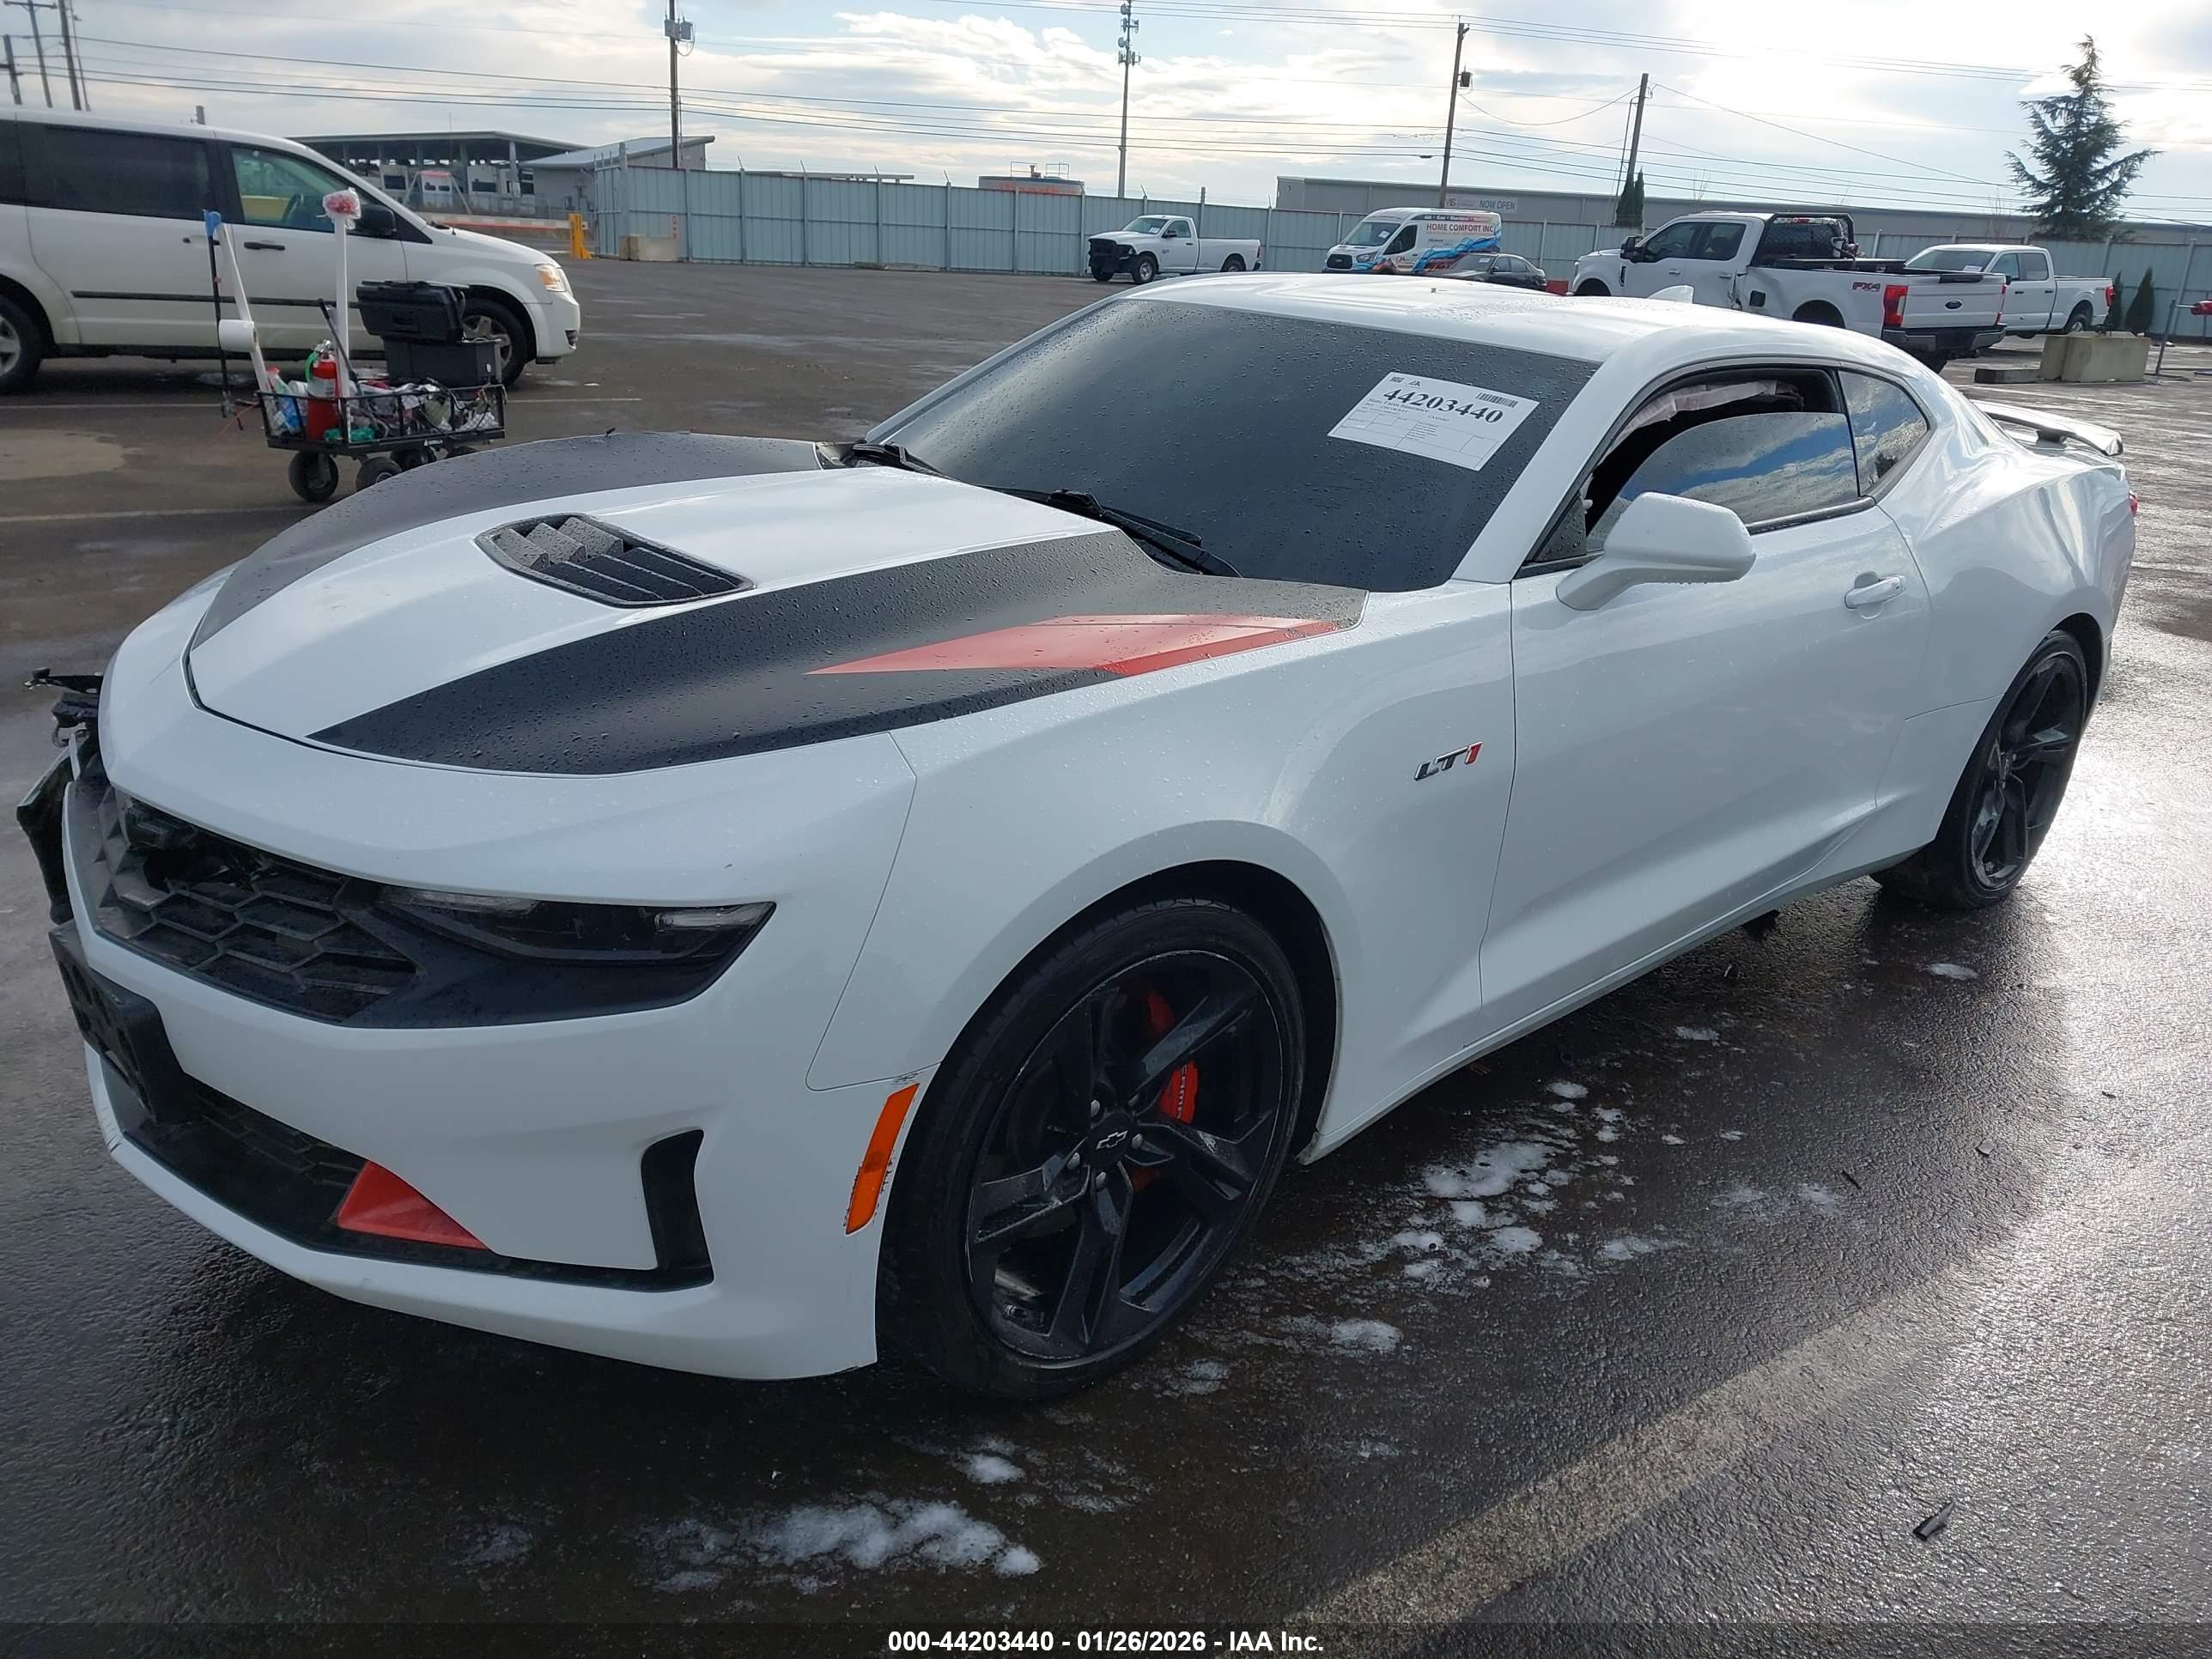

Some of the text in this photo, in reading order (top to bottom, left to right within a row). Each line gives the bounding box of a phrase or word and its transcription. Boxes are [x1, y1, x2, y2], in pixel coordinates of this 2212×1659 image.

[1479, 200, 1516, 210] NOW OPEN
[1852, 282, 1881, 292] FX4
[1383, 389, 1504, 422] 44203440
[1414, 742, 1483, 781] LT1
